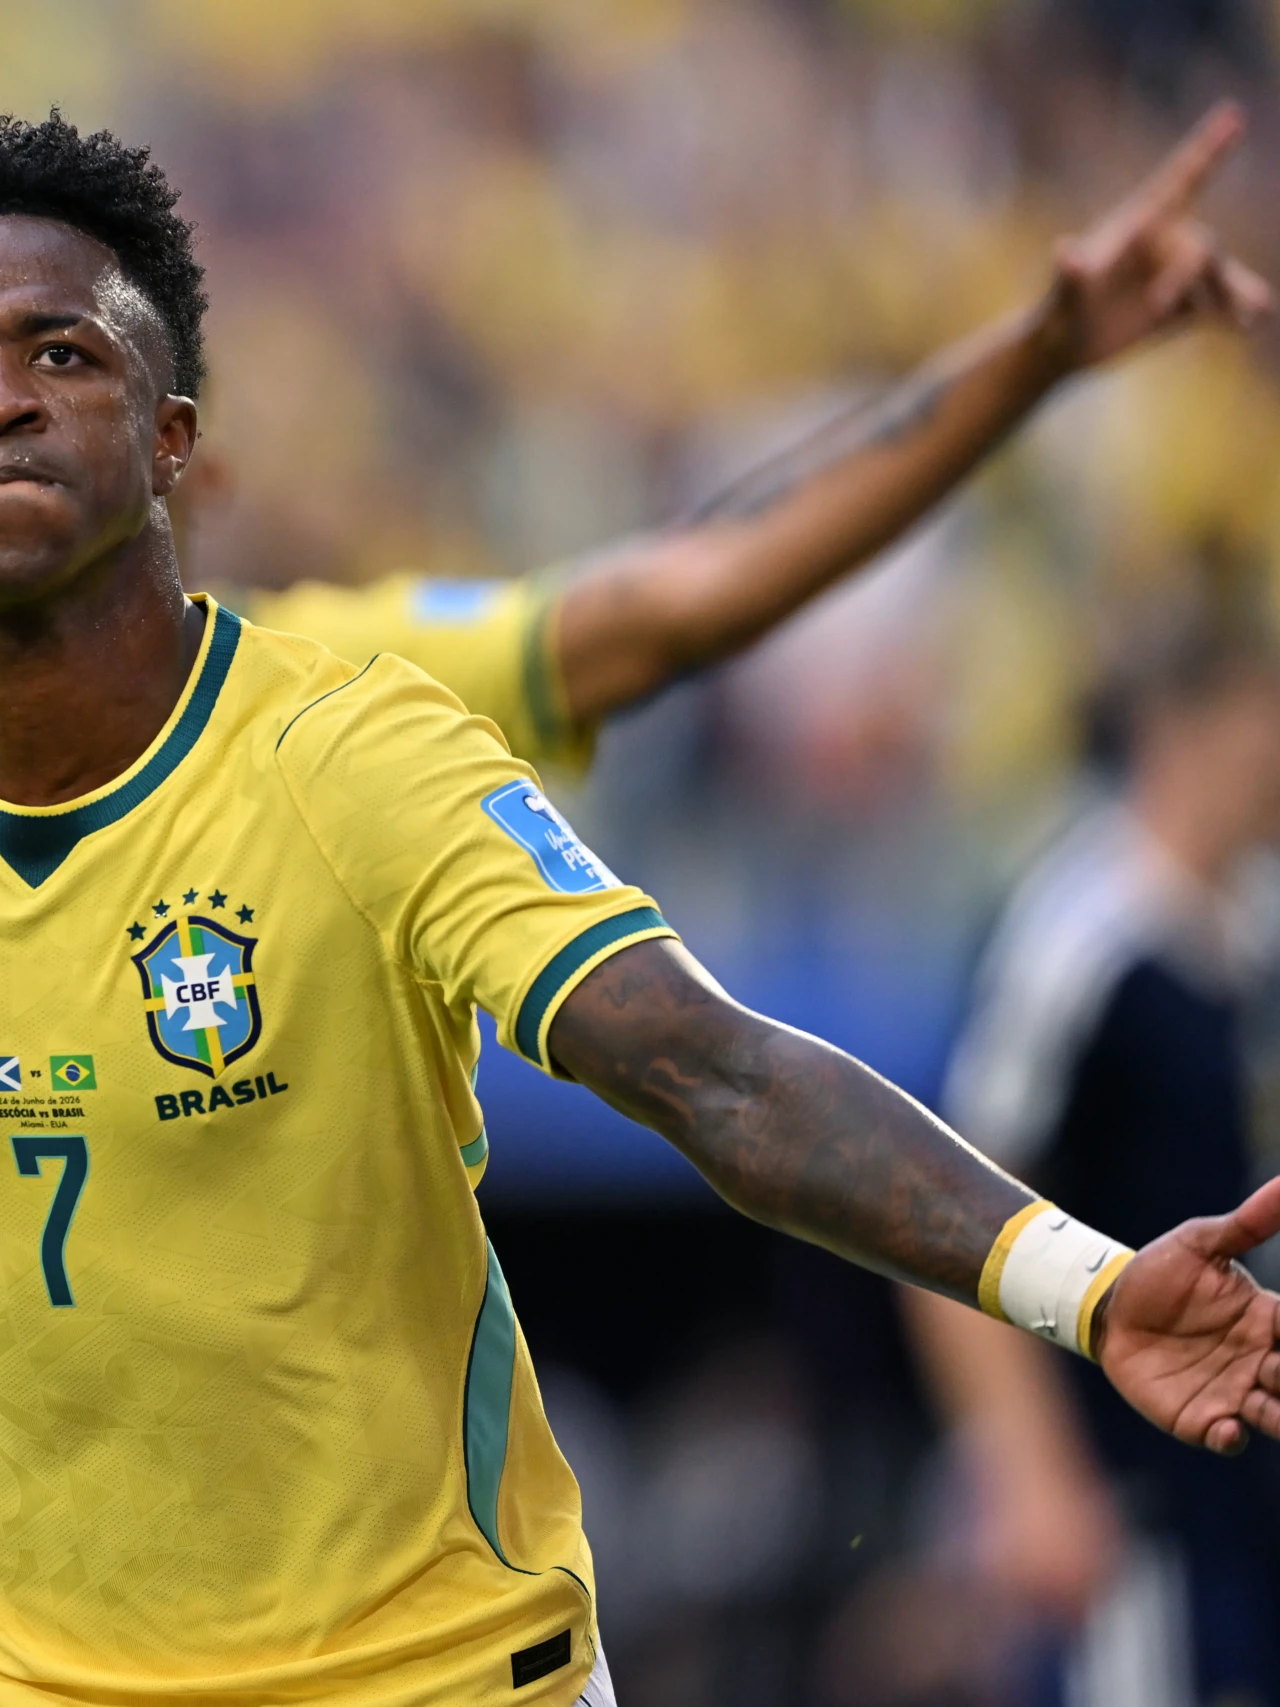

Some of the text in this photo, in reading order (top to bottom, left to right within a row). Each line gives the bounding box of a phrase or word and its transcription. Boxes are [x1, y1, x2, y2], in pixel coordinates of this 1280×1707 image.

[176, 980, 220, 1004] CBF
[10, 1096, 20, 1105] de
[22, 1096, 45, 1105] Junho
[47, 1096, 57, 1105] de
[59, 1096, 81, 1104] 2026
[154, 1072, 289, 1121] BRASIL
[51, 1108, 85, 1118] BRASIL
[20, 1120, 44, 1128] Miami
[50, 1120, 68, 1128] EUA
[9, 1134, 91, 1308] 7
